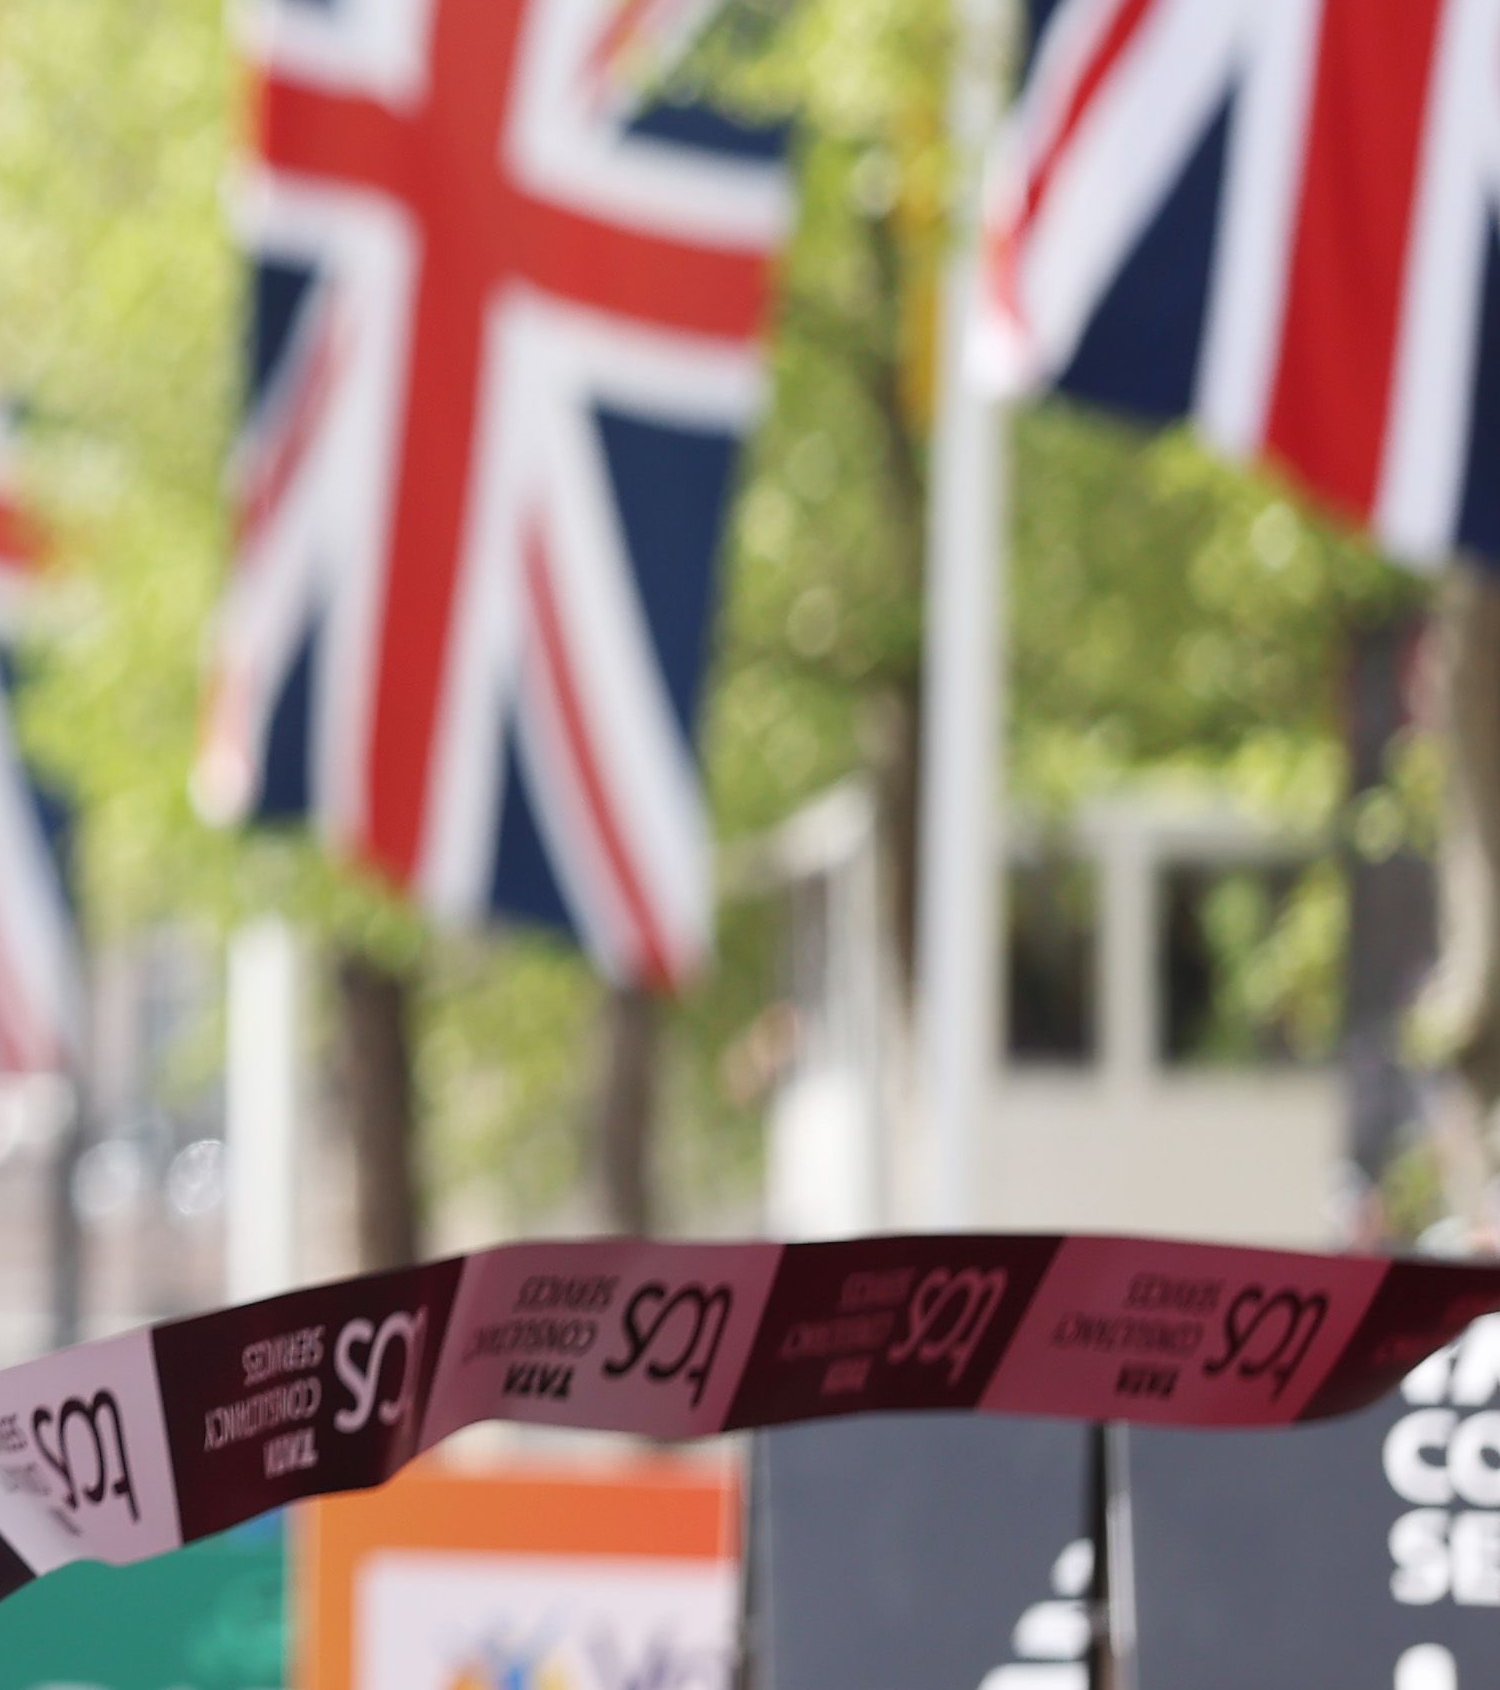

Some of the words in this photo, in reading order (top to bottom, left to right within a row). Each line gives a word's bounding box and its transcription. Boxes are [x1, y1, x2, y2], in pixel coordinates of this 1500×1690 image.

[502, 1362, 575, 1400] TATA
[602, 1281, 734, 1410] tcs
[887, 1266, 1009, 1386] tcs
[1202, 1283, 1331, 1403] tcs
[32, 1388, 141, 1523] tcs
